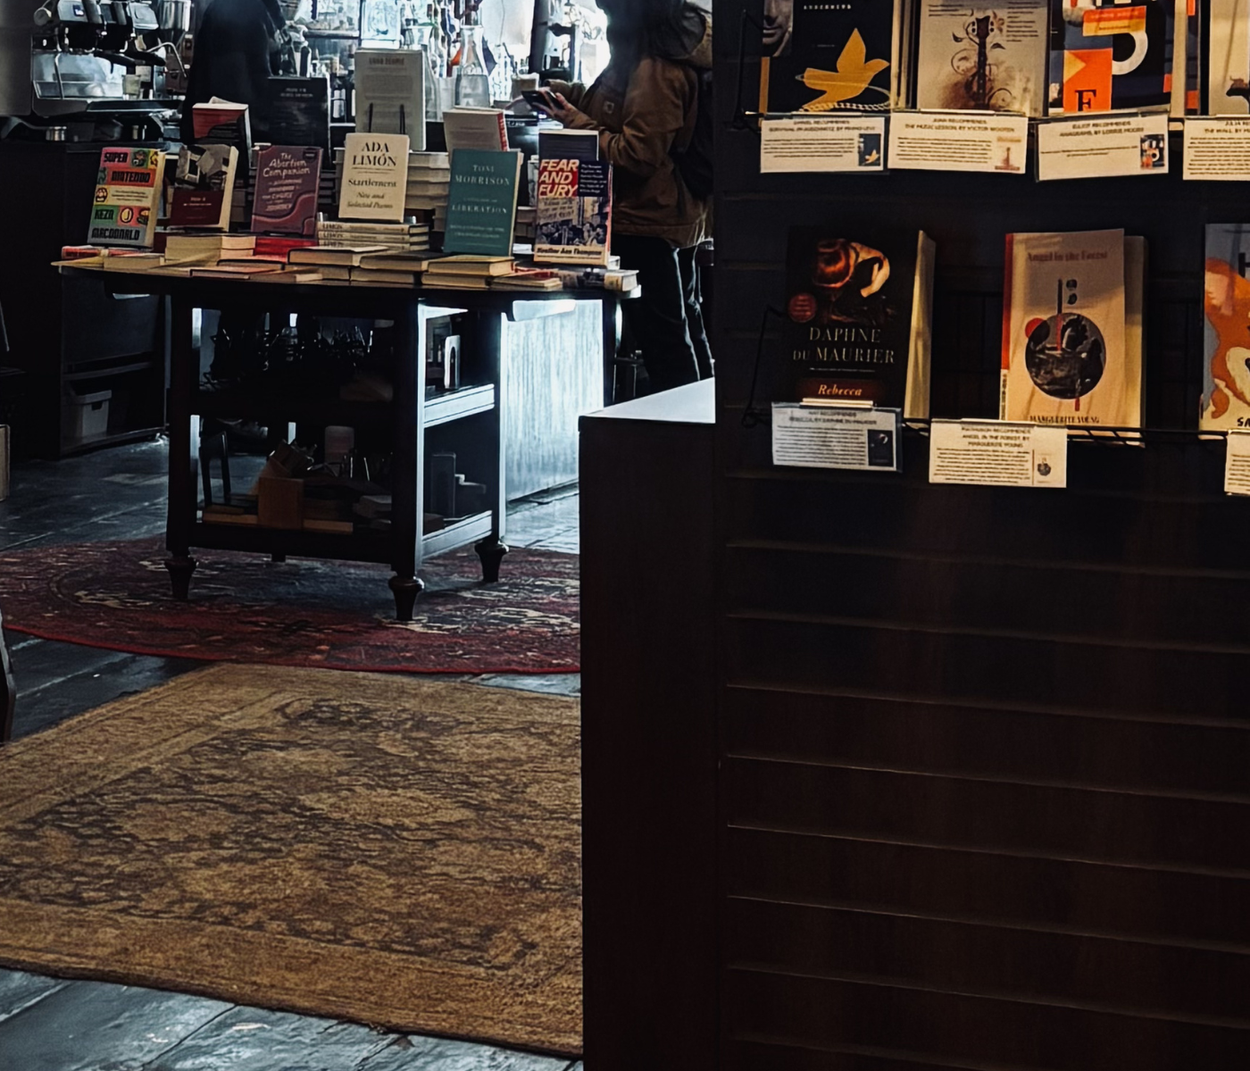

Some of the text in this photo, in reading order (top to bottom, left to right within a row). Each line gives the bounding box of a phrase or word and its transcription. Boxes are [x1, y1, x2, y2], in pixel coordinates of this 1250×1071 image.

[361, 141, 390, 153] ADA
[103, 151, 129, 163] SUPER
[352, 153, 397, 167] LIMÓN
[268, 159, 307, 169] Abortion
[472, 164, 495, 173] TONI
[539, 159, 580, 172] FEAR
[111, 171, 151, 184] NINTENDO
[262, 168, 311, 179] Companion
[539, 172, 572, 184] AND
[348, 178, 397, 188] Startlement
[455, 175, 510, 186] MORRISON
[539, 185, 578, 198] FURY
[452, 204, 507, 214] LIBERATION
[91, 227, 141, 241] MACDONALD
[560, 247, 573, 255] Ann
[573, 247, 602, 256] Thompson
[809, 326, 882, 343] DAPHNE
[815, 346, 895, 364] MAURIER
[817, 383, 863, 396] Rebecca
